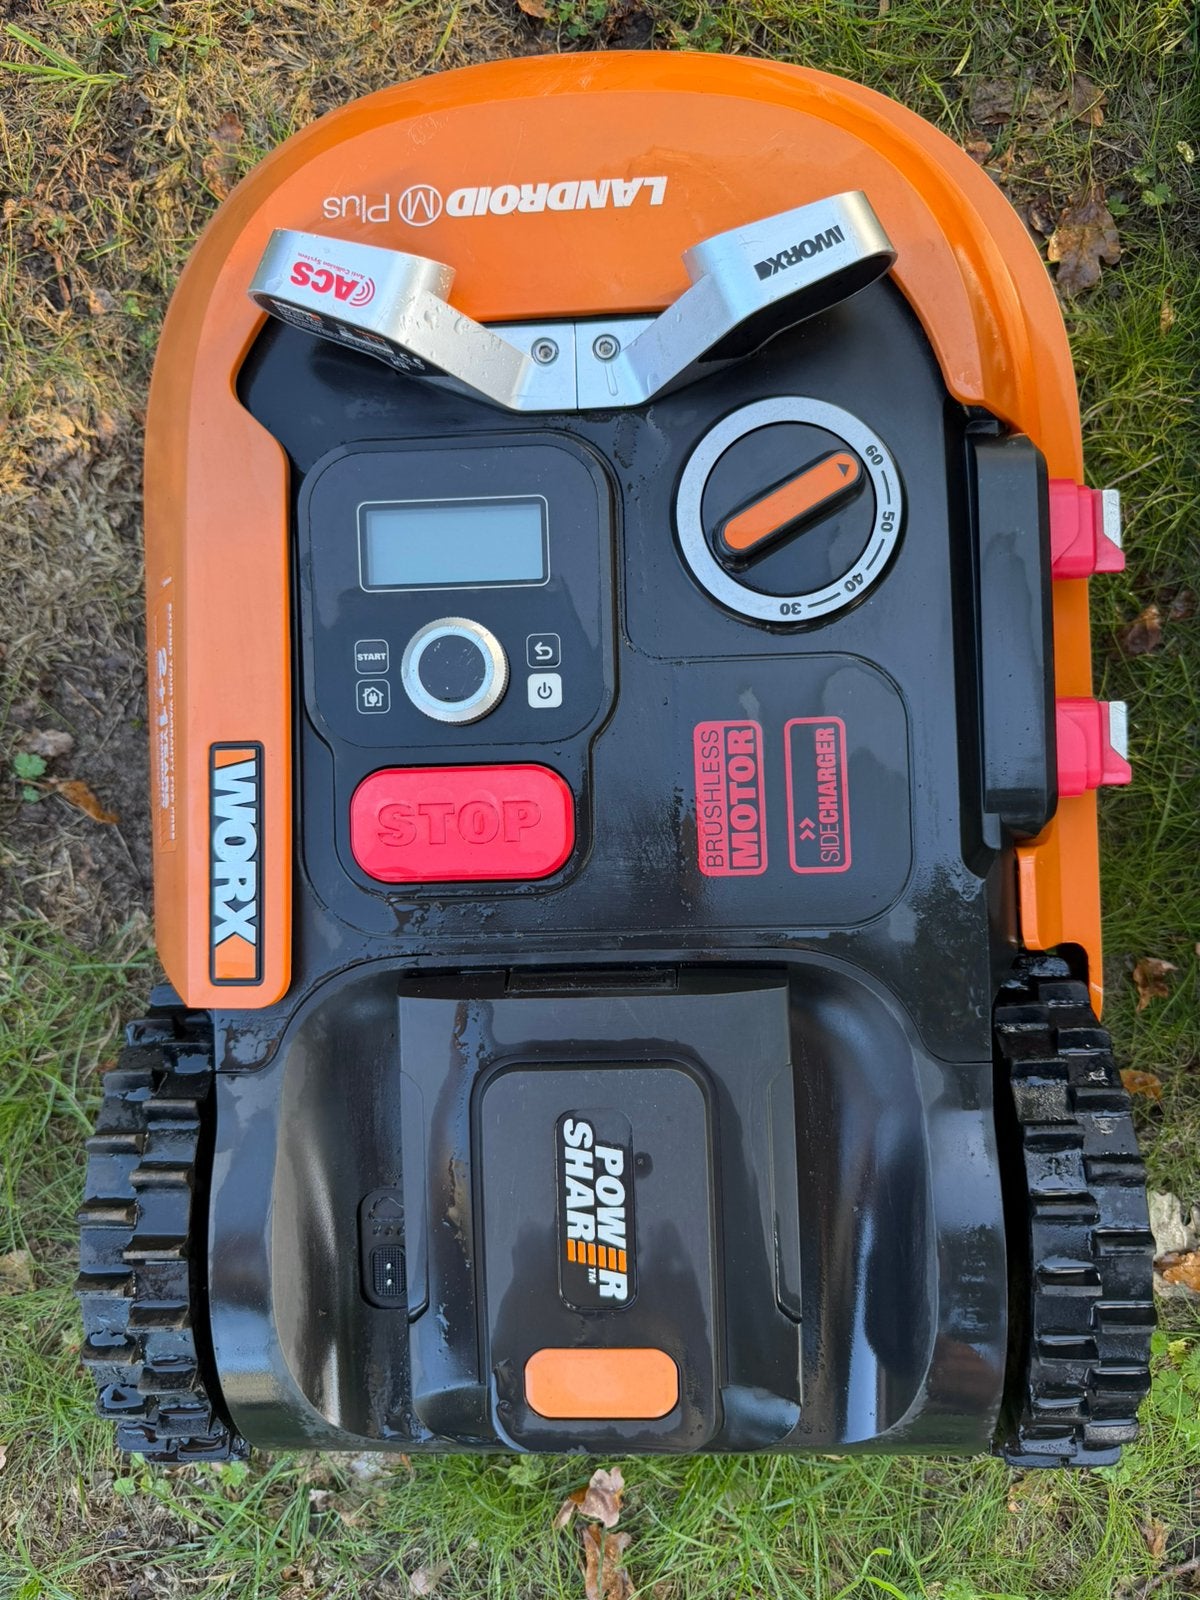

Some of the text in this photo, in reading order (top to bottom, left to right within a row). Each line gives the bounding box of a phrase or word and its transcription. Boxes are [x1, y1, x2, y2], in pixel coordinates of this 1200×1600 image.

[322, 193, 390, 224] Plus
[446, 176, 668, 217] LANDROID
[297, 251, 366, 281] Anti Collision System
[772, 224, 846, 276] WORX
[290, 261, 361, 301] ACS
[864, 444, 884, 466] 60
[880, 511, 895, 533] 50
[843, 572, 864, 592] 40
[779, 602, 802, 616] 30
[356, 652, 387, 662] START
[700, 729, 724, 868] BRUSHLESS
[727, 728, 760, 868] MOTOR
[815, 727, 841, 863] SIDECHARGER
[377, 800, 542, 847] STOP
[214, 757, 258, 948] WORX
[563, 1118, 597, 1267] SHARE
[595, 1145, 629, 1301] POWER
